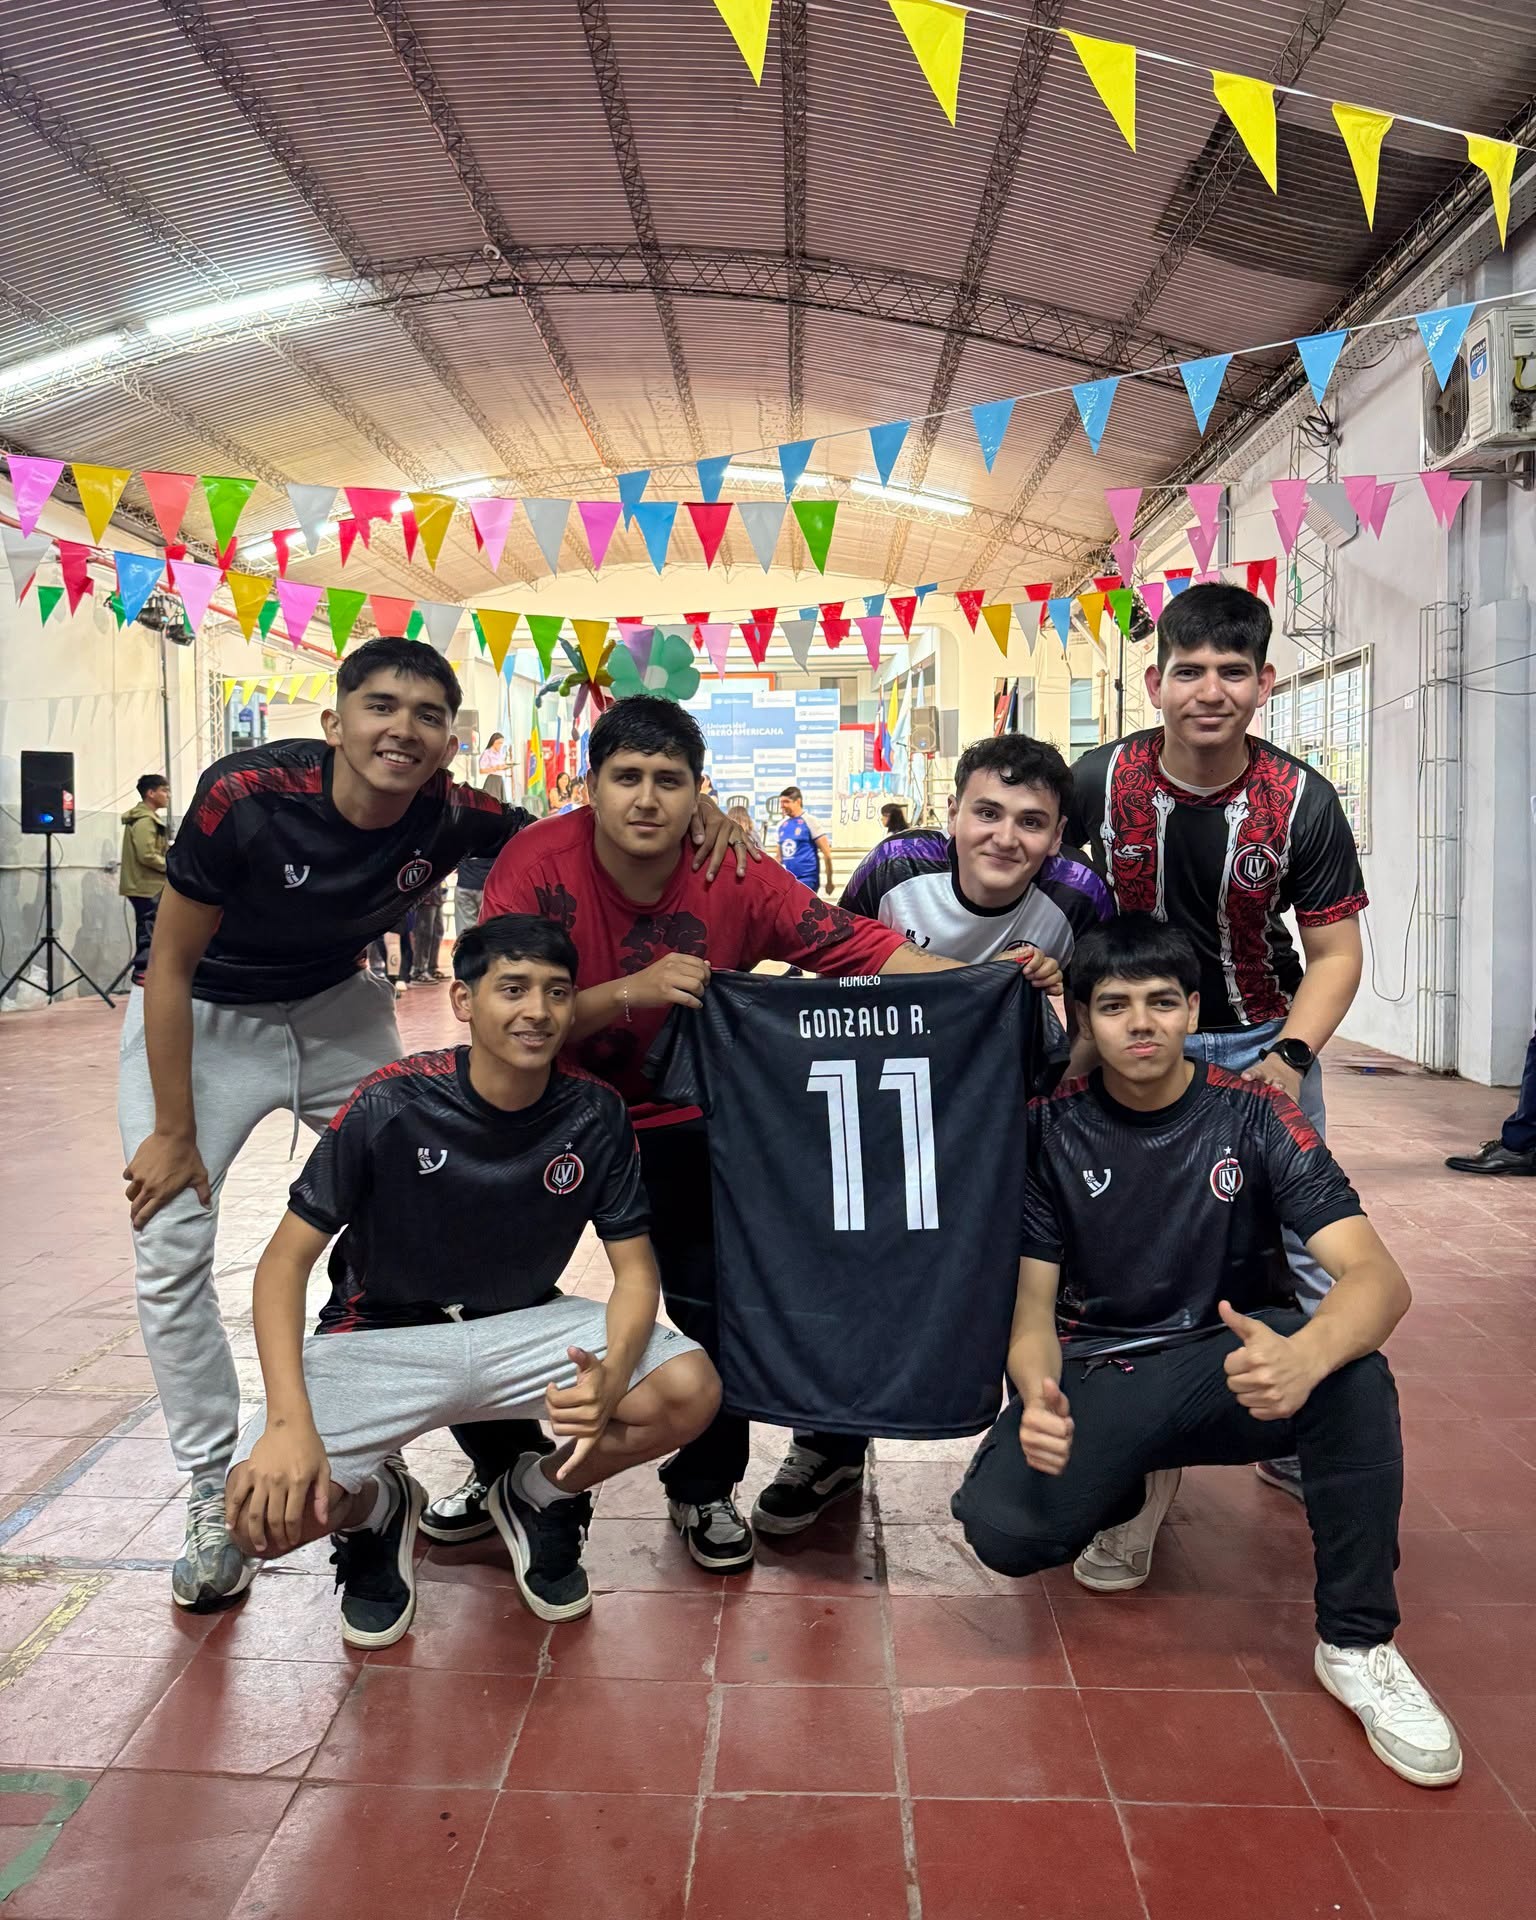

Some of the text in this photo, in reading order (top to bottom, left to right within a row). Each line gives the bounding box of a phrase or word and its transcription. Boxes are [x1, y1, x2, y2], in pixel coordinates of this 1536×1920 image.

[707, 728, 784, 736] IBEROAMERICANA
[1248, 857, 1266, 880] LV
[799, 1004, 931, 1038] GONZALO R.
[806, 1057, 939, 1231] 11
[1221, 1170, 1237, 1191] LV
